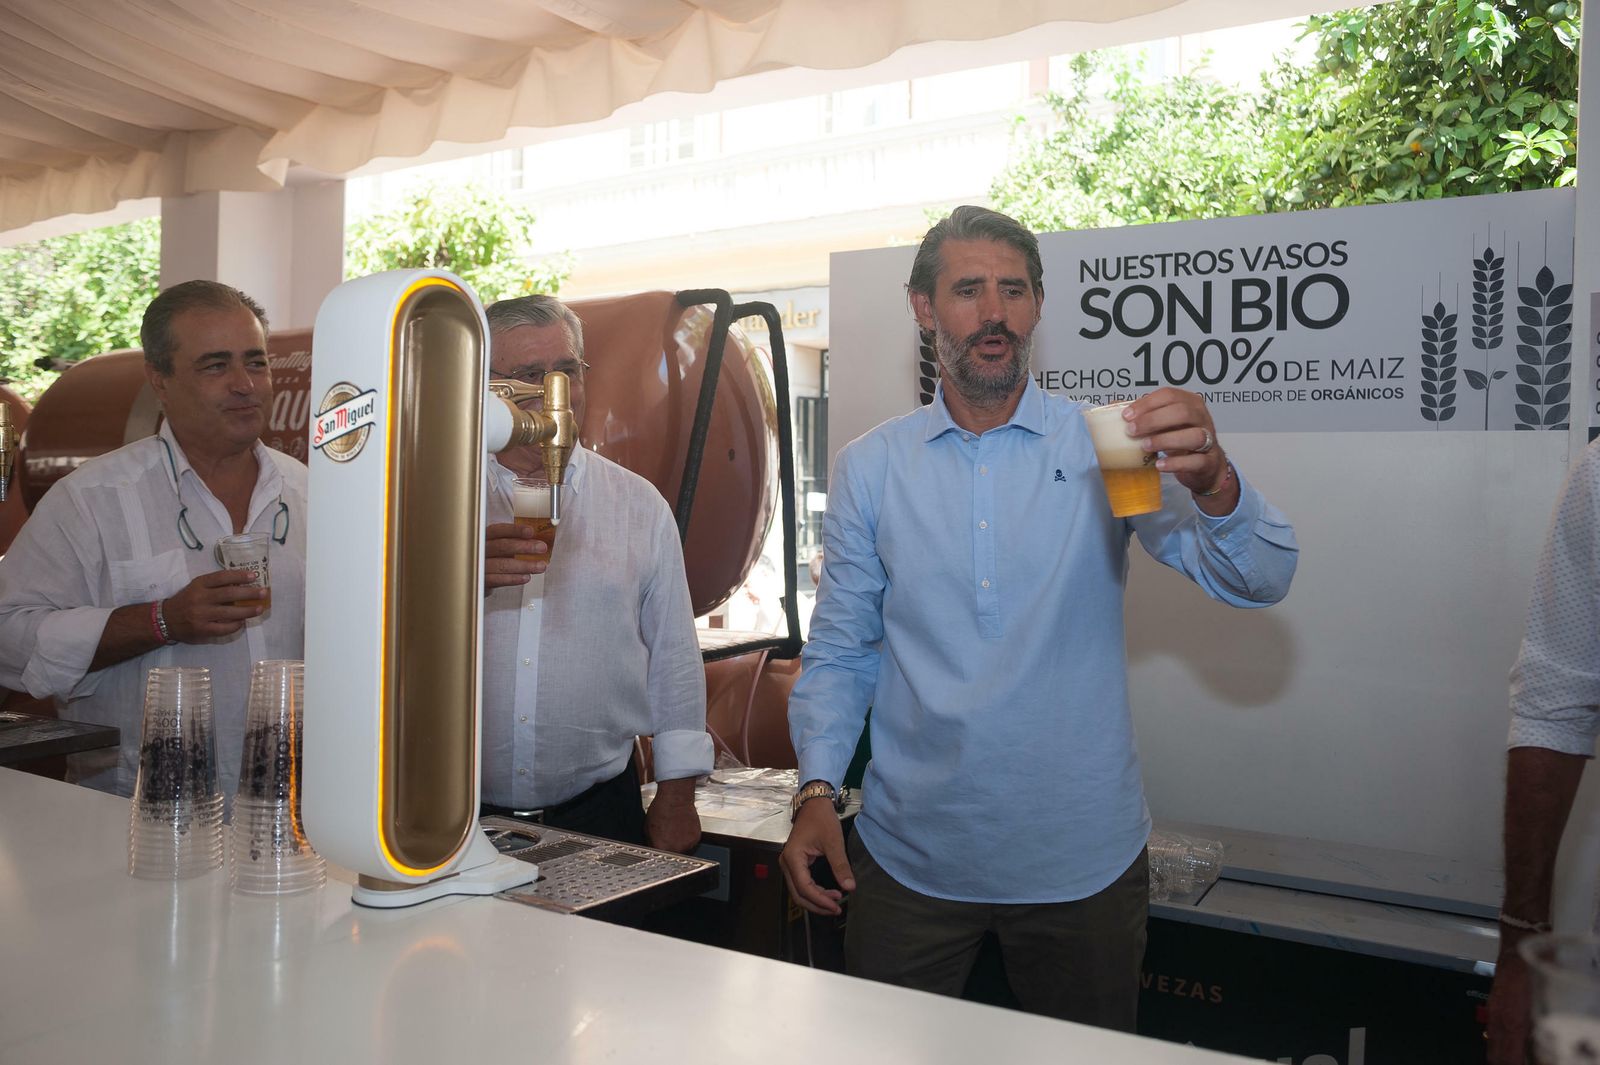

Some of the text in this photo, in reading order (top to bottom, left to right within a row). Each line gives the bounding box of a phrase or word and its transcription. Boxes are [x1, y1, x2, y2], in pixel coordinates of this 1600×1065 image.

[1080, 240, 1348, 283] NUESTROS VASOS
[1079, 273, 1350, 340] SON BIO
[1035, 337, 1405, 390] HECHOS 100% DE MAIZ
[1195, 390, 1283, 403] ONTENEDOR
[1287, 389, 1307, 401] DE
[1311, 386, 1405, 401] ORGÁNICOS
[314, 417, 336, 444] San
[335, 397, 374, 430] Miguel
[1141, 973, 1223, 1003] VEZAS
